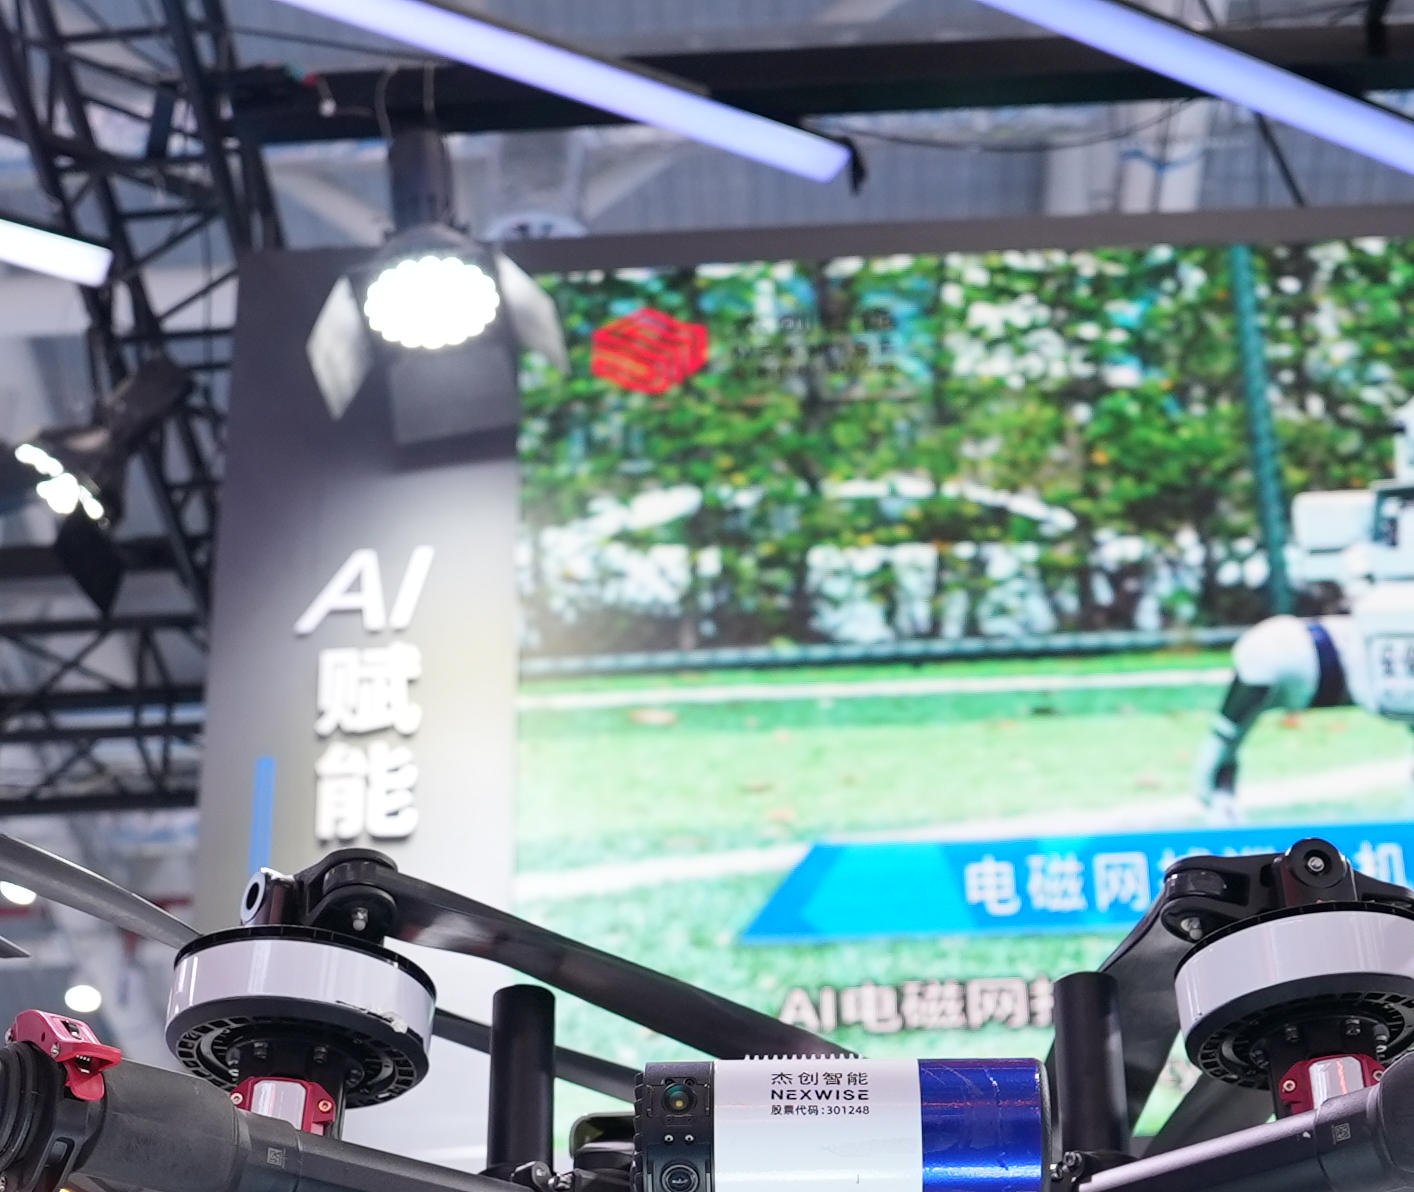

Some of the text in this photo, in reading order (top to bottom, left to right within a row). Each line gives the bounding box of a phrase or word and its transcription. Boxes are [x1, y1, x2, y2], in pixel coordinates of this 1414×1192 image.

[770, 1071, 870, 1087] 杰创智能
[770, 1089, 870, 1101] NEXWISE
[770, 1104, 871, 1117] 股票代码:301248
